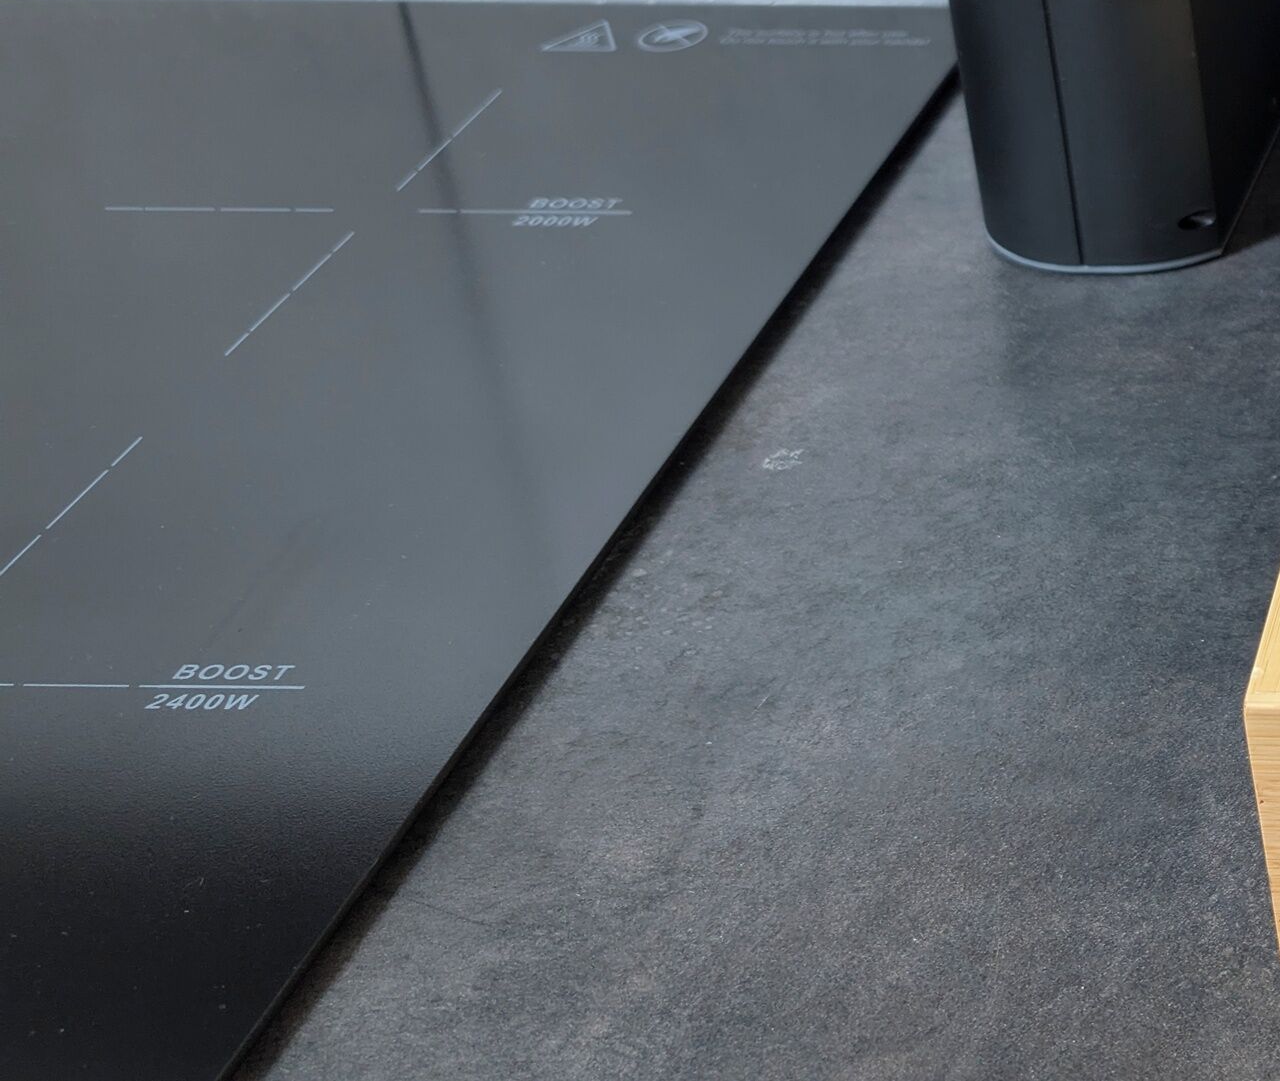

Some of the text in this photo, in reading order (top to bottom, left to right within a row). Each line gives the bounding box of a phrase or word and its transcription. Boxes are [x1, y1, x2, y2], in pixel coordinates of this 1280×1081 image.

[529, 198, 623, 210] BOOST
[512, 215, 599, 227] 2000W
[171, 663, 297, 681] BOOST
[144, 693, 260, 710] 2400W
